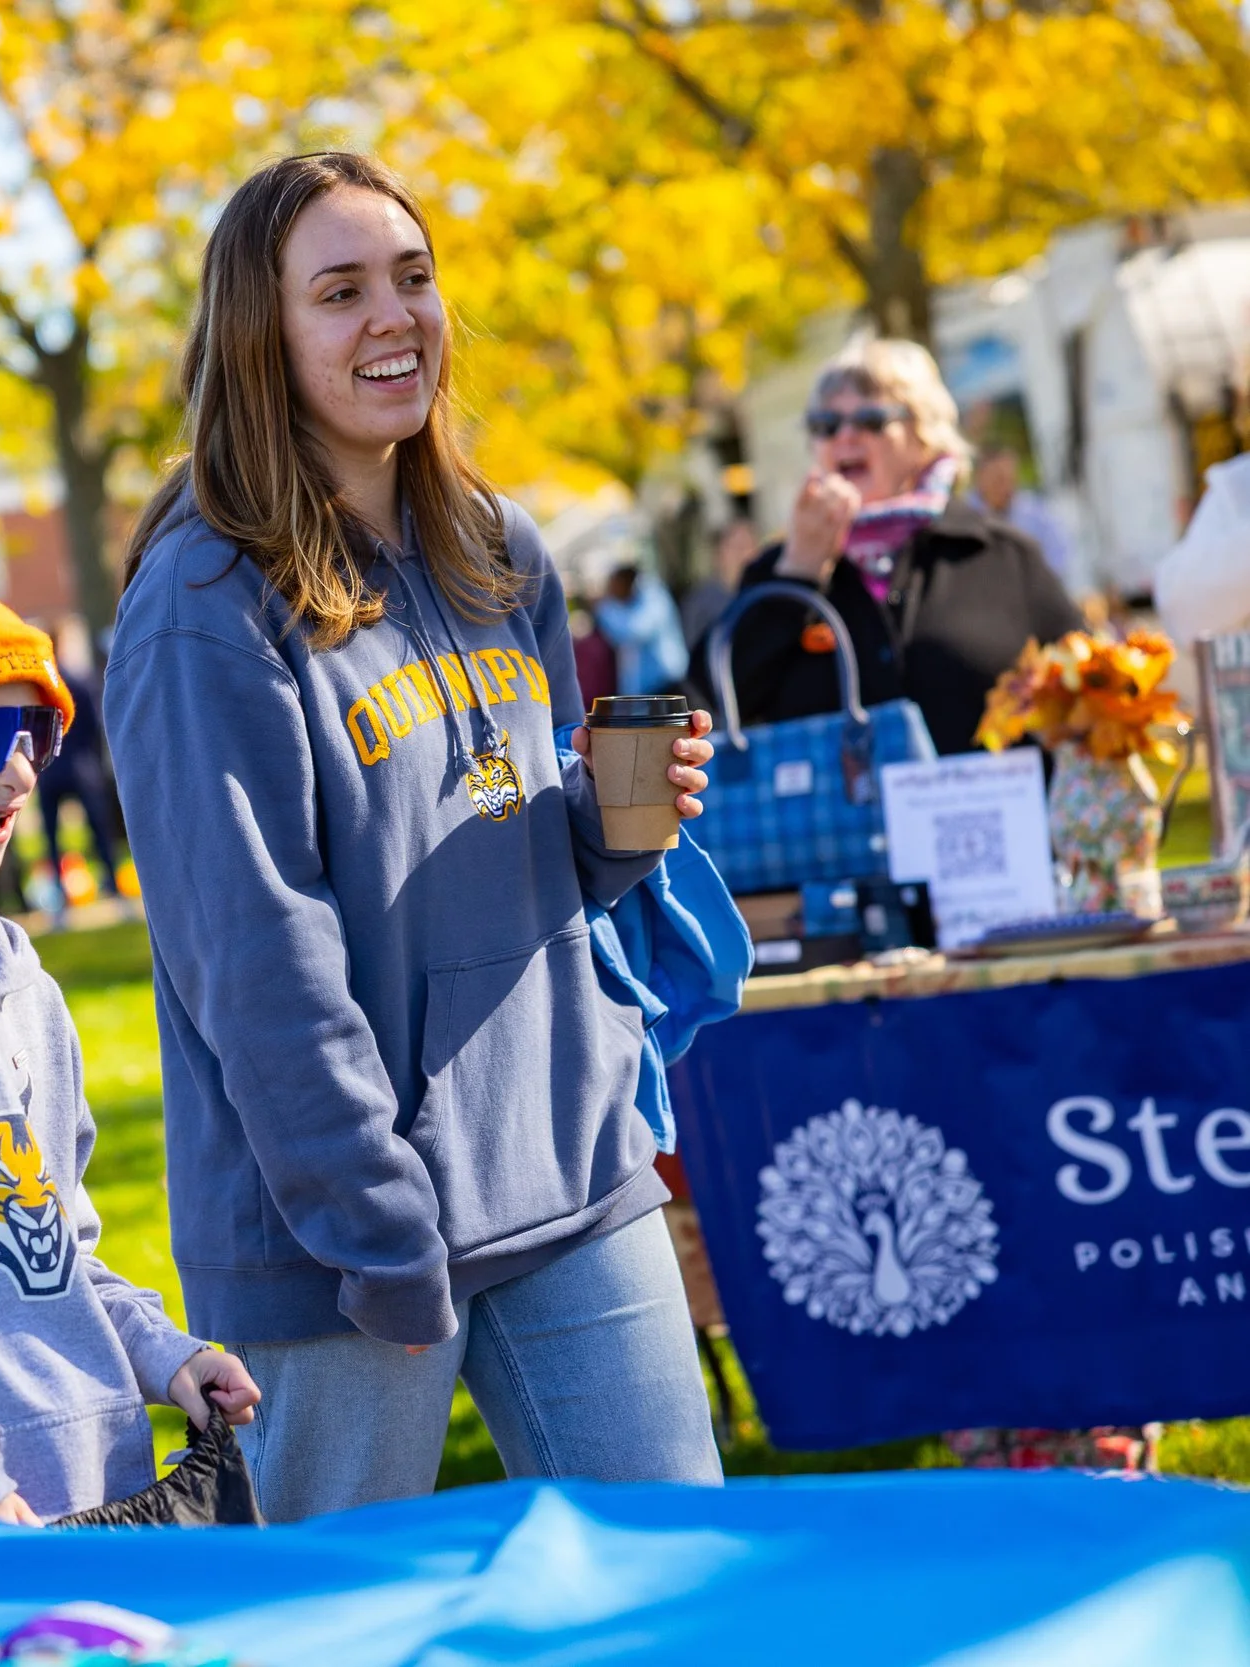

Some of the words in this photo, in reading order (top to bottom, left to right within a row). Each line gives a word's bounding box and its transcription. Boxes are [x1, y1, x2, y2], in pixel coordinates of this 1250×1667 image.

[1046, 1095, 1250, 1205] Ste
[1073, 1227, 1250, 1272] POLIS
[1178, 1271, 1246, 1307] AN
